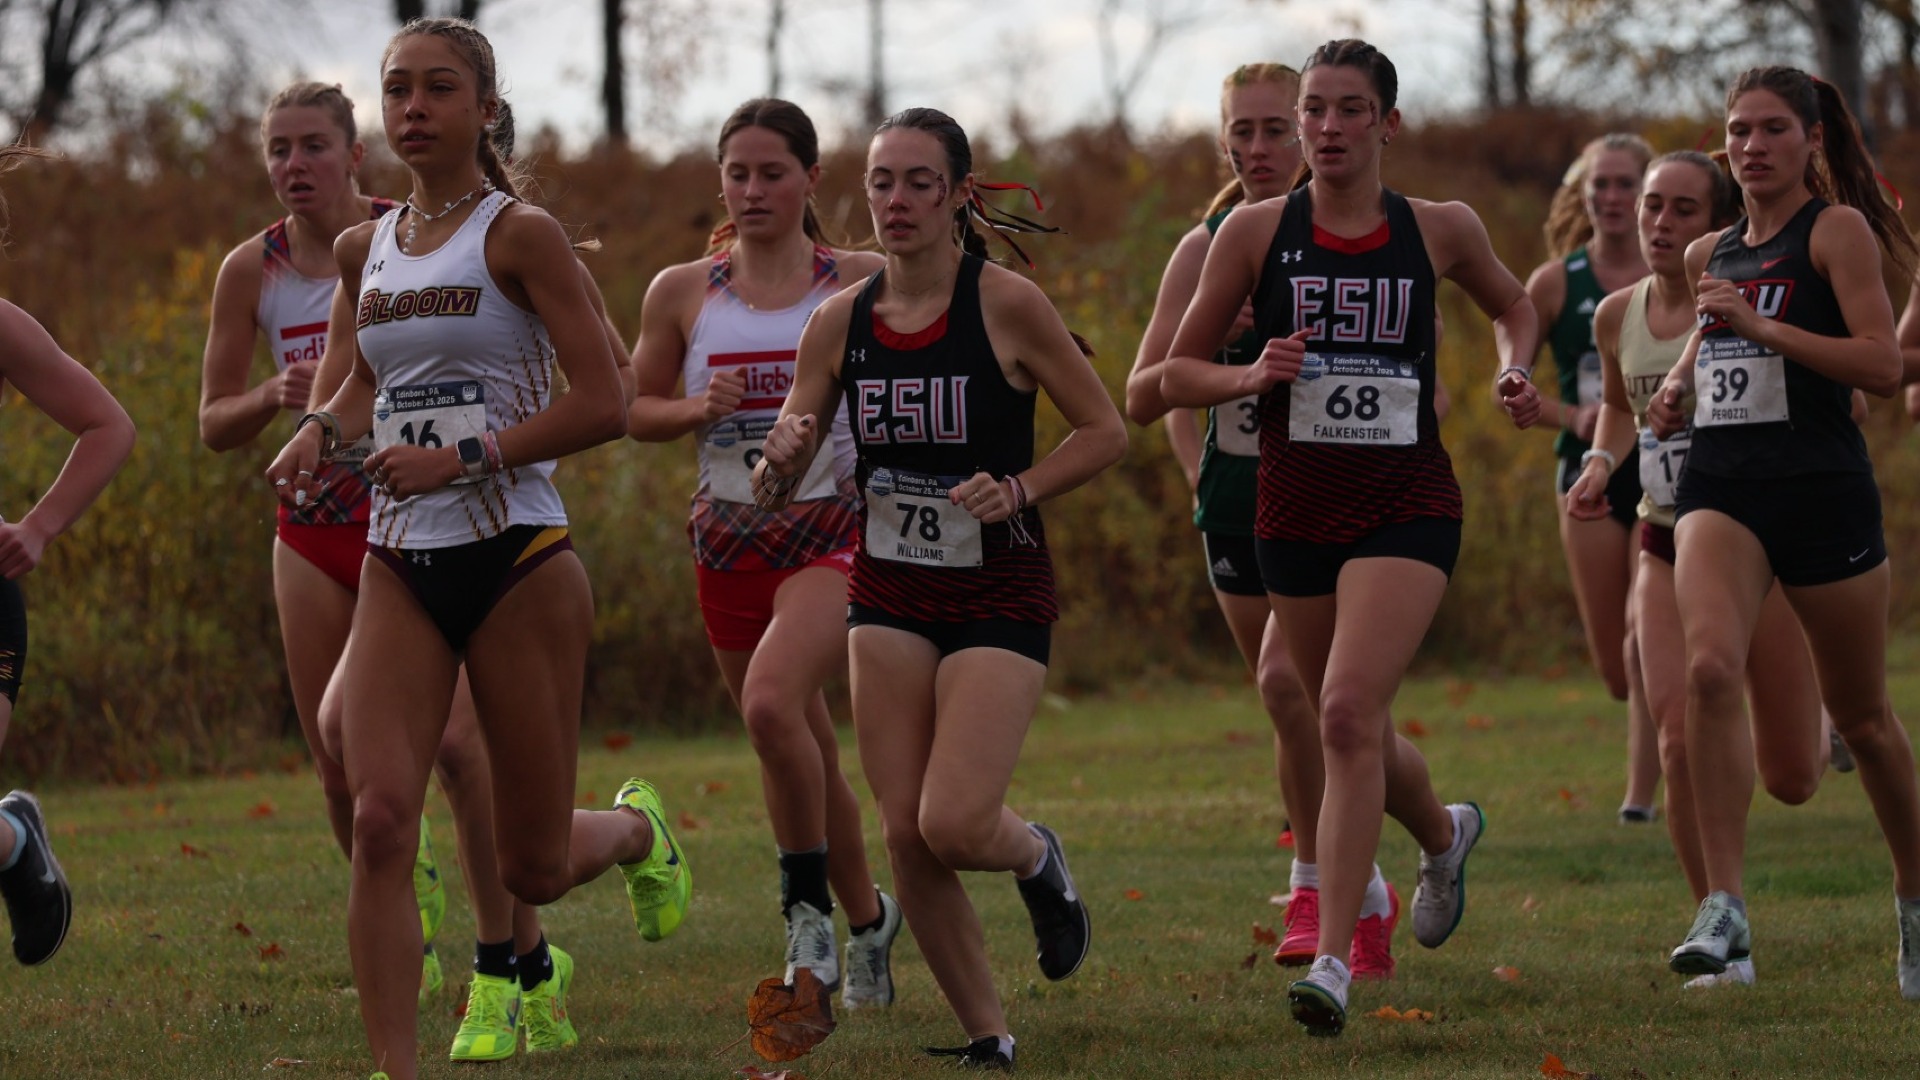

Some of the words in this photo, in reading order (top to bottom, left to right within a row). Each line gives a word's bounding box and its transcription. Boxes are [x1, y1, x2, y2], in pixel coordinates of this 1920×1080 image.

[357, 287, 481, 331] BLOOM
[1288, 276, 1414, 344] ESU
[1332, 366, 1362, 374] October
[1377, 368, 1395, 376] 2025
[1370, 358, 1380, 366] PA
[429, 387, 440, 396] PA
[1624, 374, 1669, 399] UTZ
[1712, 367, 1749, 404] 39
[396, 399, 424, 410] October
[437, 396, 456, 405] 2025
[855, 375, 970, 444] ESU
[1325, 384, 1381, 421] 68
[1712, 408, 1749, 420] PEROZZI
[400, 419, 443, 448] 16
[1313, 424, 1391, 440] FALKENSTEIN
[898, 484, 923, 494] October
[935, 488, 950, 497] 202
[928, 479, 938, 487] PA
[896, 502, 942, 542] 78
[897, 542, 944, 561] WILLIAMS
